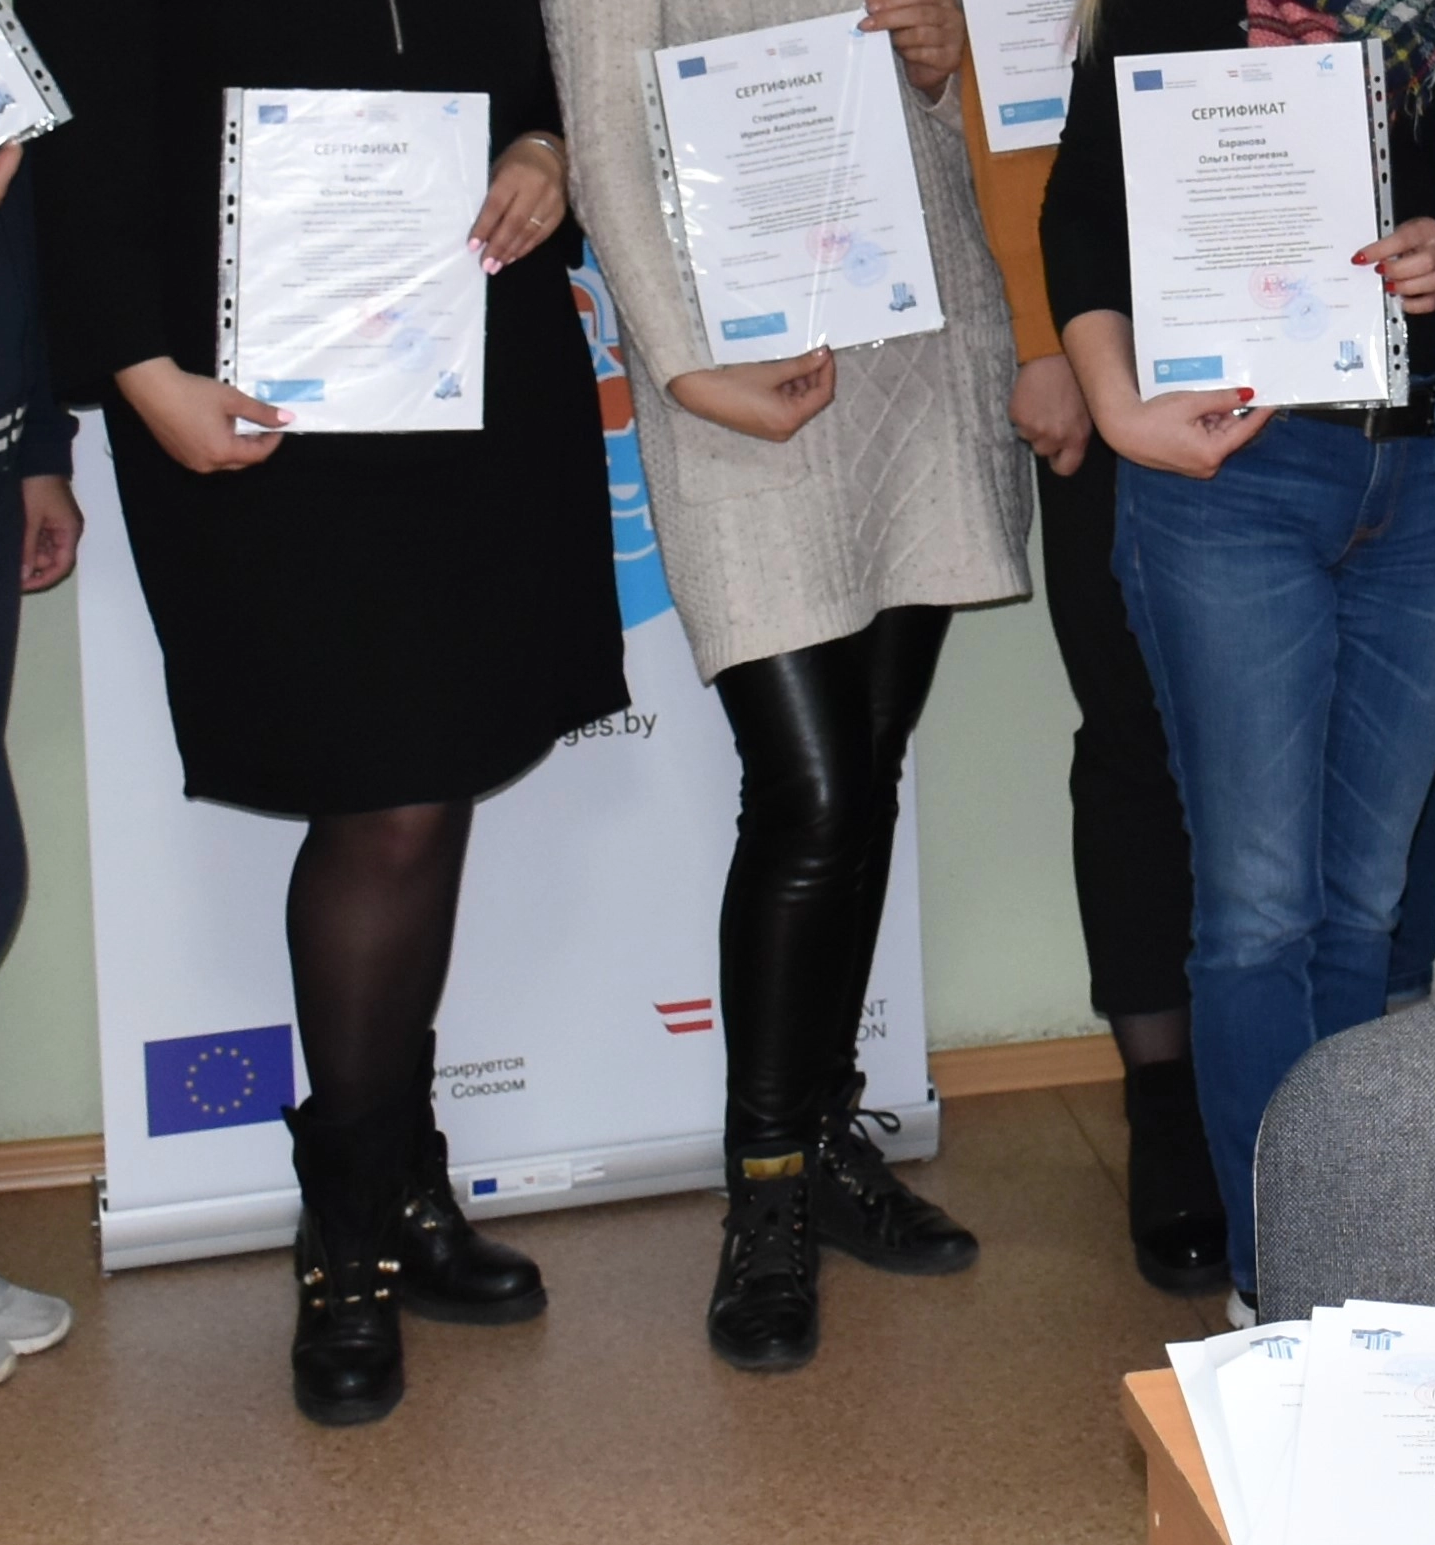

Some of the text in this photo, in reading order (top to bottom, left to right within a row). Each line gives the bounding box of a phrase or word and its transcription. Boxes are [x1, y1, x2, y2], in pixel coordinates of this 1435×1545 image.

[735, 71, 823, 99] СЕРТИФИКАТ
[1191, 102, 1285, 121] СЕРТИФИКАТ
[1217, 137, 1267, 149] Баранова
[1198, 150, 1289, 165] Ольга Георгиевна
[451, 1079, 526, 1099] Союзом
